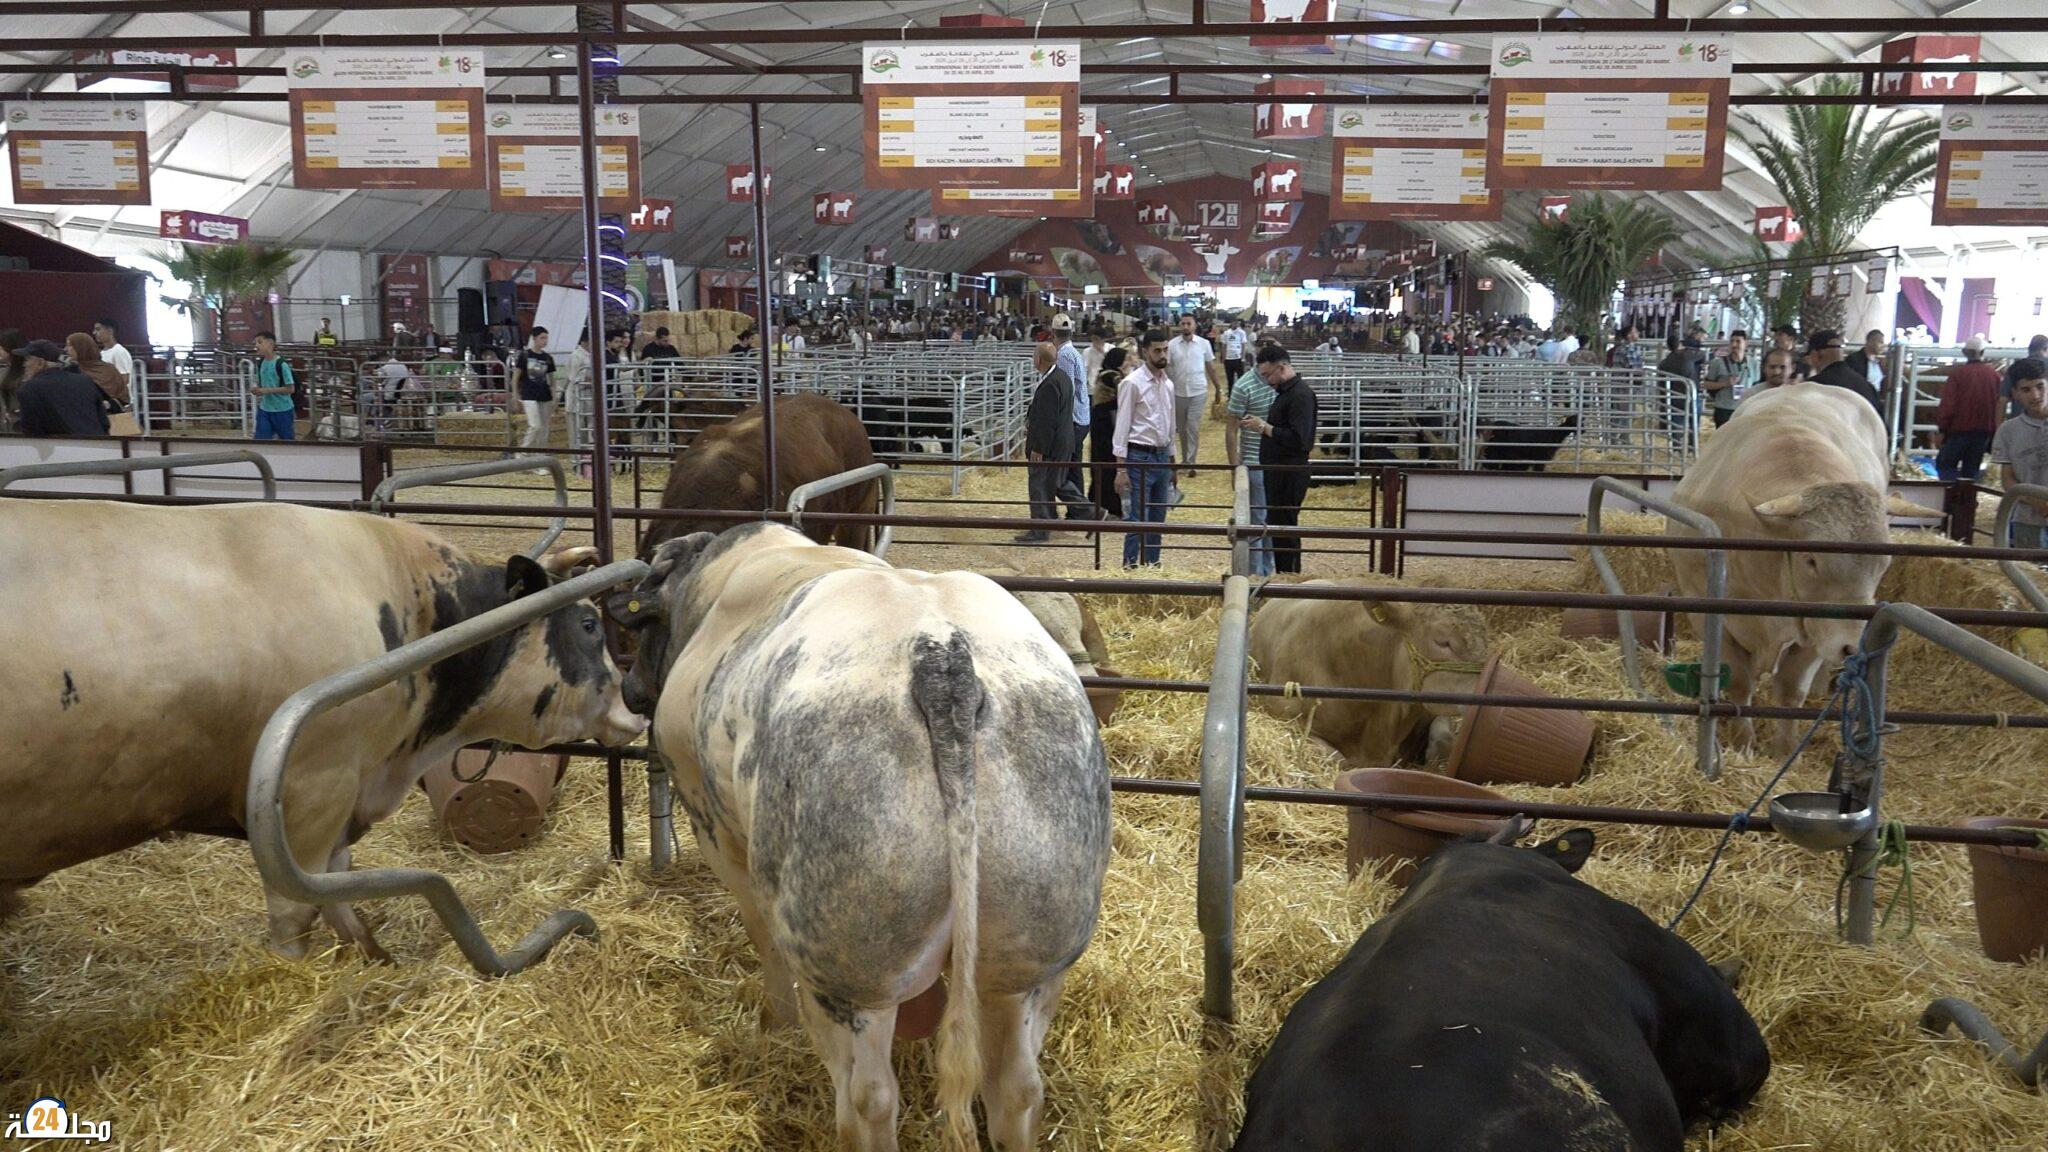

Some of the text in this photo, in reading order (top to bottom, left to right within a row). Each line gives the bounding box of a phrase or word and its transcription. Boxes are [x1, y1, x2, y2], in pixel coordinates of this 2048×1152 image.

[1049, 49, 1067, 67] 18
[1698, 43, 1718, 63] 18
[454, 56, 471, 73] 18
[616, 112, 629, 125] 18
[1198, 203, 1225, 226] 12
